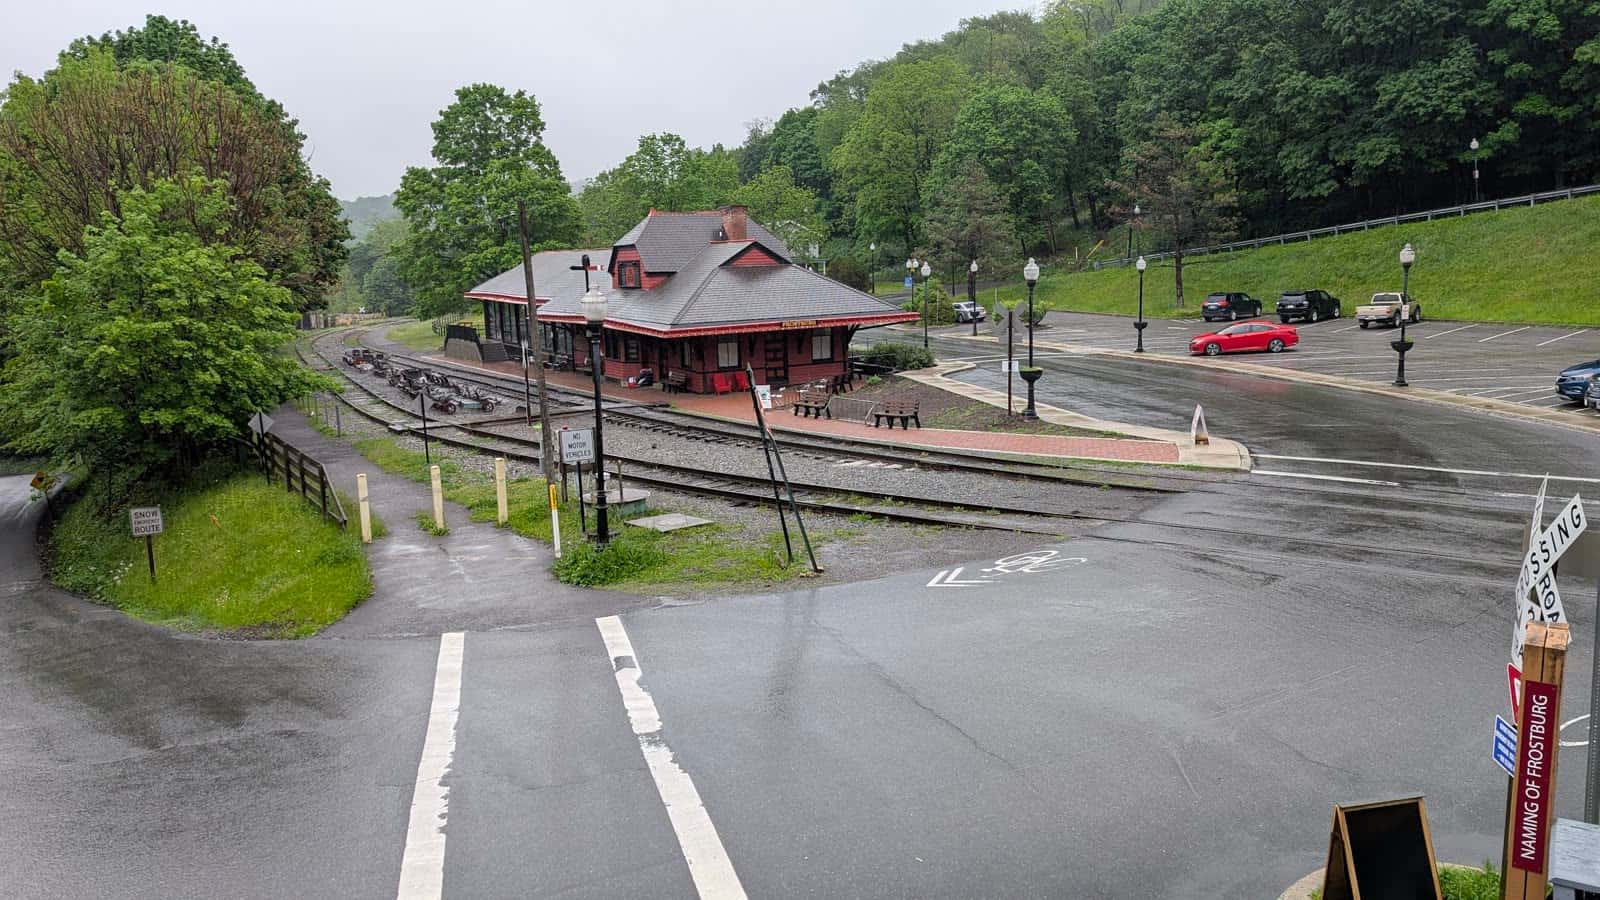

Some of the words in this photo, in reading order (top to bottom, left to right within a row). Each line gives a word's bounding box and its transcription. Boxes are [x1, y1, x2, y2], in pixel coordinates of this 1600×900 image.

[567, 441, 586, 449] MOTOR
[134, 511, 157, 519] SNOW
[135, 525, 160, 533] ROUTE
[1527, 694, 1548, 778] FROSTBURG
[1525, 778, 1541, 801] OF
[1520, 801, 1540, 860] NAMING
